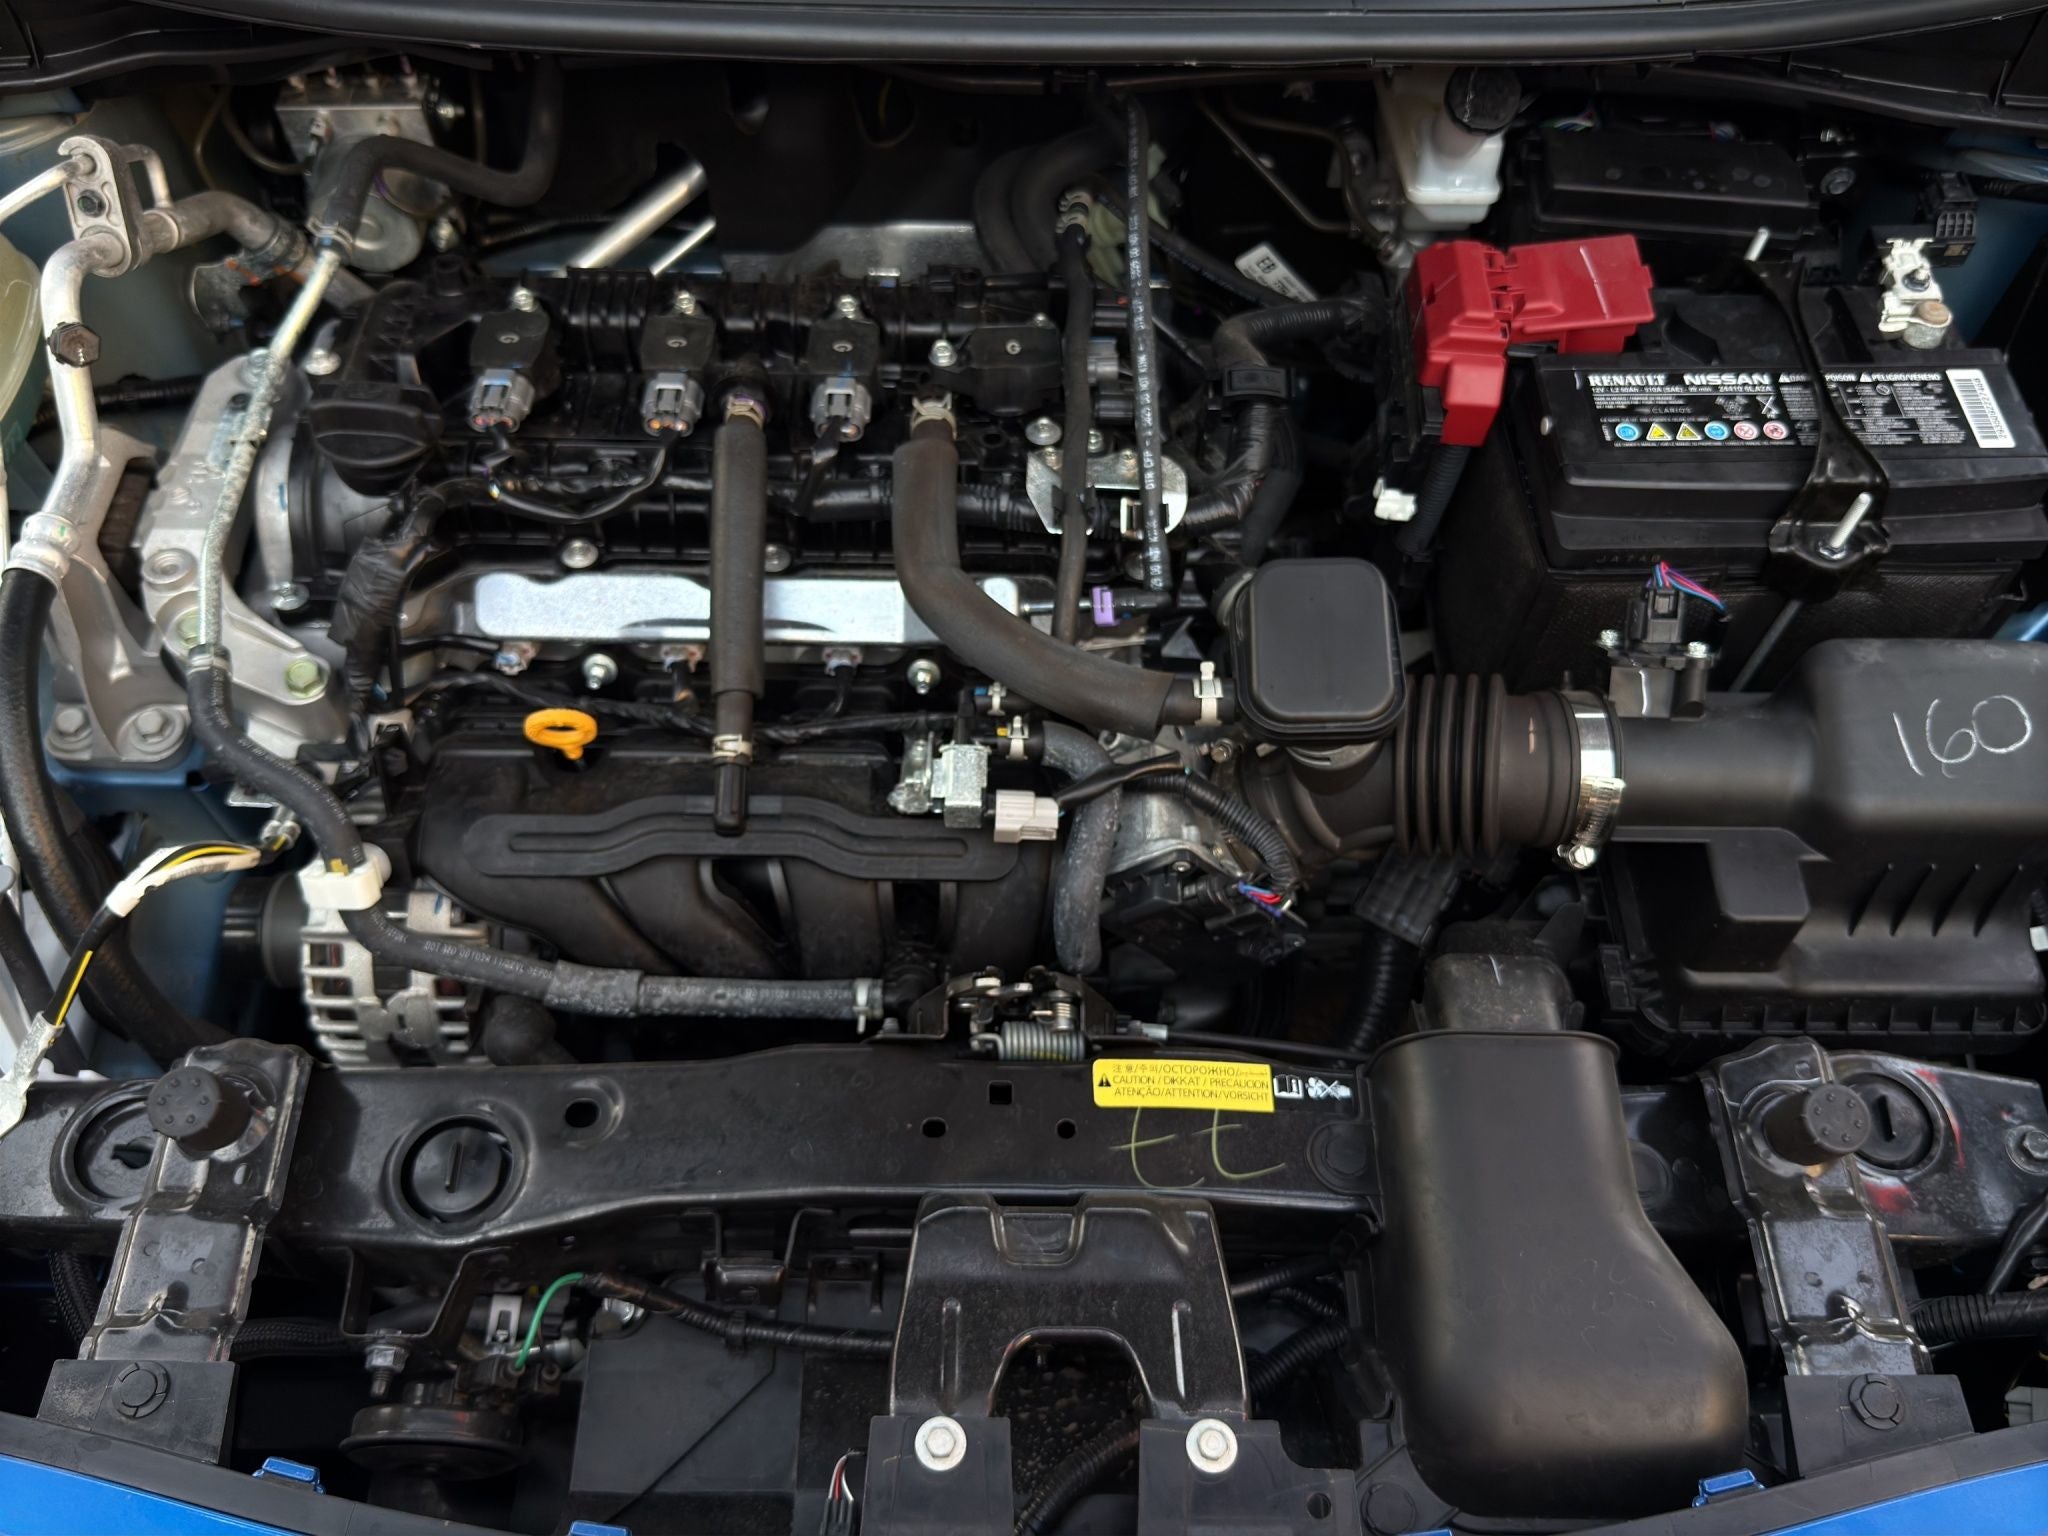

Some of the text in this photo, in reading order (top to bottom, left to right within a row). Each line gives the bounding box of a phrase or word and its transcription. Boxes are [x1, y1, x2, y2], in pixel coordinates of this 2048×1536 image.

[1588, 372, 1771, 386] RENAULT NISSAN
[1592, 386, 1604, 394] 12V
[1892, 694, 2033, 778] 160
[1113, 1074, 1155, 1085] CAUTION
[1209, 1077, 1269, 1089] PRECAUCION
